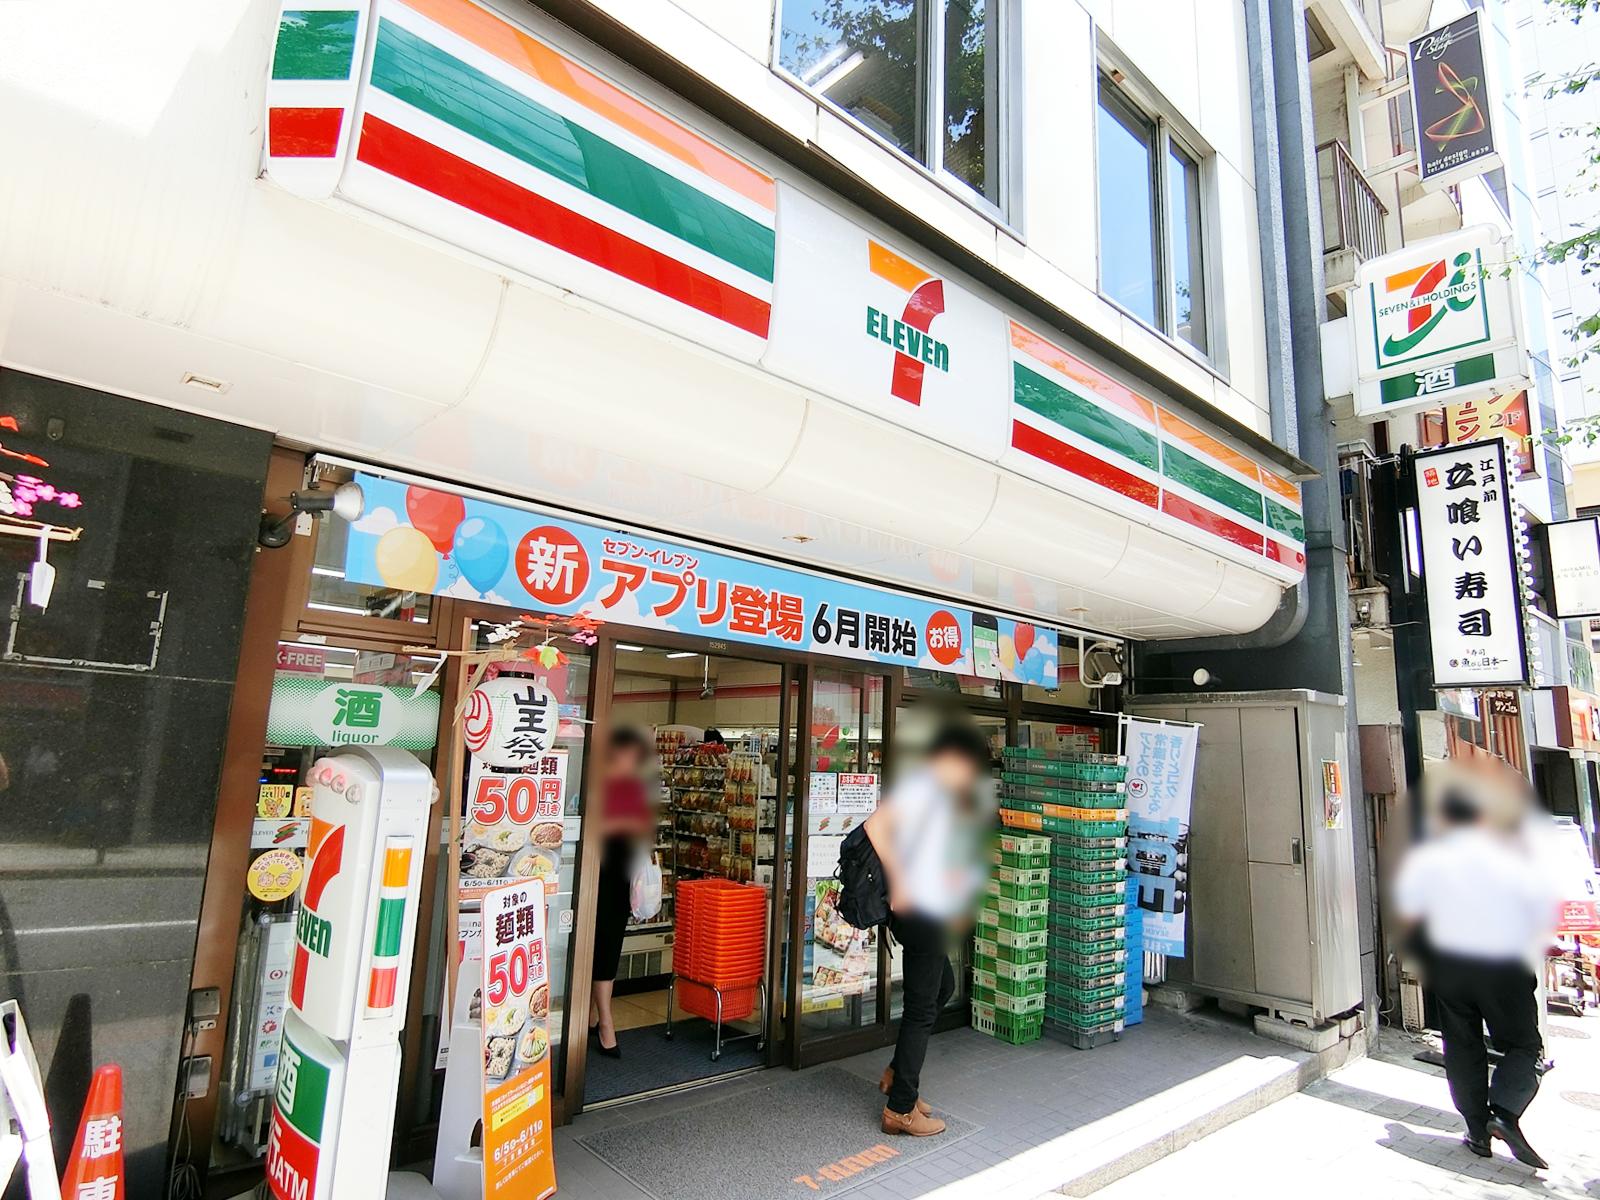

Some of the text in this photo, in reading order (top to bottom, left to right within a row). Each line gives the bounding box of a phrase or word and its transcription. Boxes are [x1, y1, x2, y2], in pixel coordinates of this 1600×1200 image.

[1427, 149, 1468, 169] hair design
[1423, 281, 1477, 304] HOLDINGS
[1415, 363, 1456, 396] 酒
[1489, 412, 1520, 429] 2F
[1480, 458, 1498, 503] 江戸前
[526, 536, 579, 595] 新
[600, 559, 804, 642] アプリ登場
[812, 603, 917, 657] 6月開始
[928, 625, 960, 650] お得
[333, 689, 382, 728] 酒
[501, 685, 549, 760] 山王祭
[331, 730, 380, 745] liquor
[502, 891, 528, 908] 対象の
[495, 904, 535, 947] 麺類
